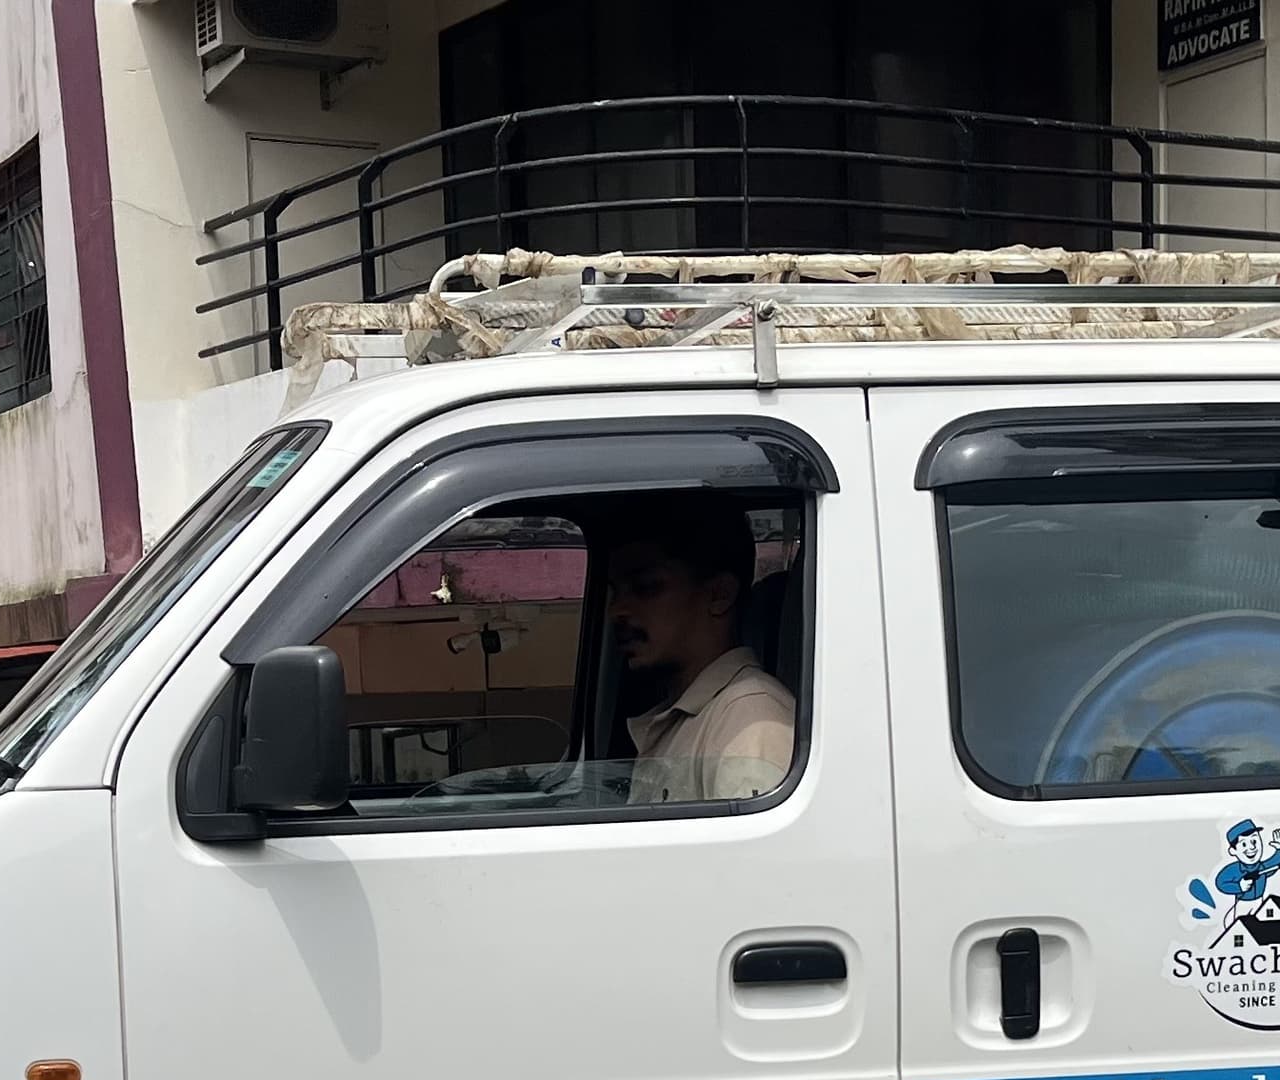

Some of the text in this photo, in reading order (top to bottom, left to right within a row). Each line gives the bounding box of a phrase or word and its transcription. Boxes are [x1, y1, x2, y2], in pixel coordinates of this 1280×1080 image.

[1167, 18, 1250, 65] ADVOCATE
[1206, 979, 1276, 993] Cleaning
[1239, 995, 1276, 1008] SINCE
